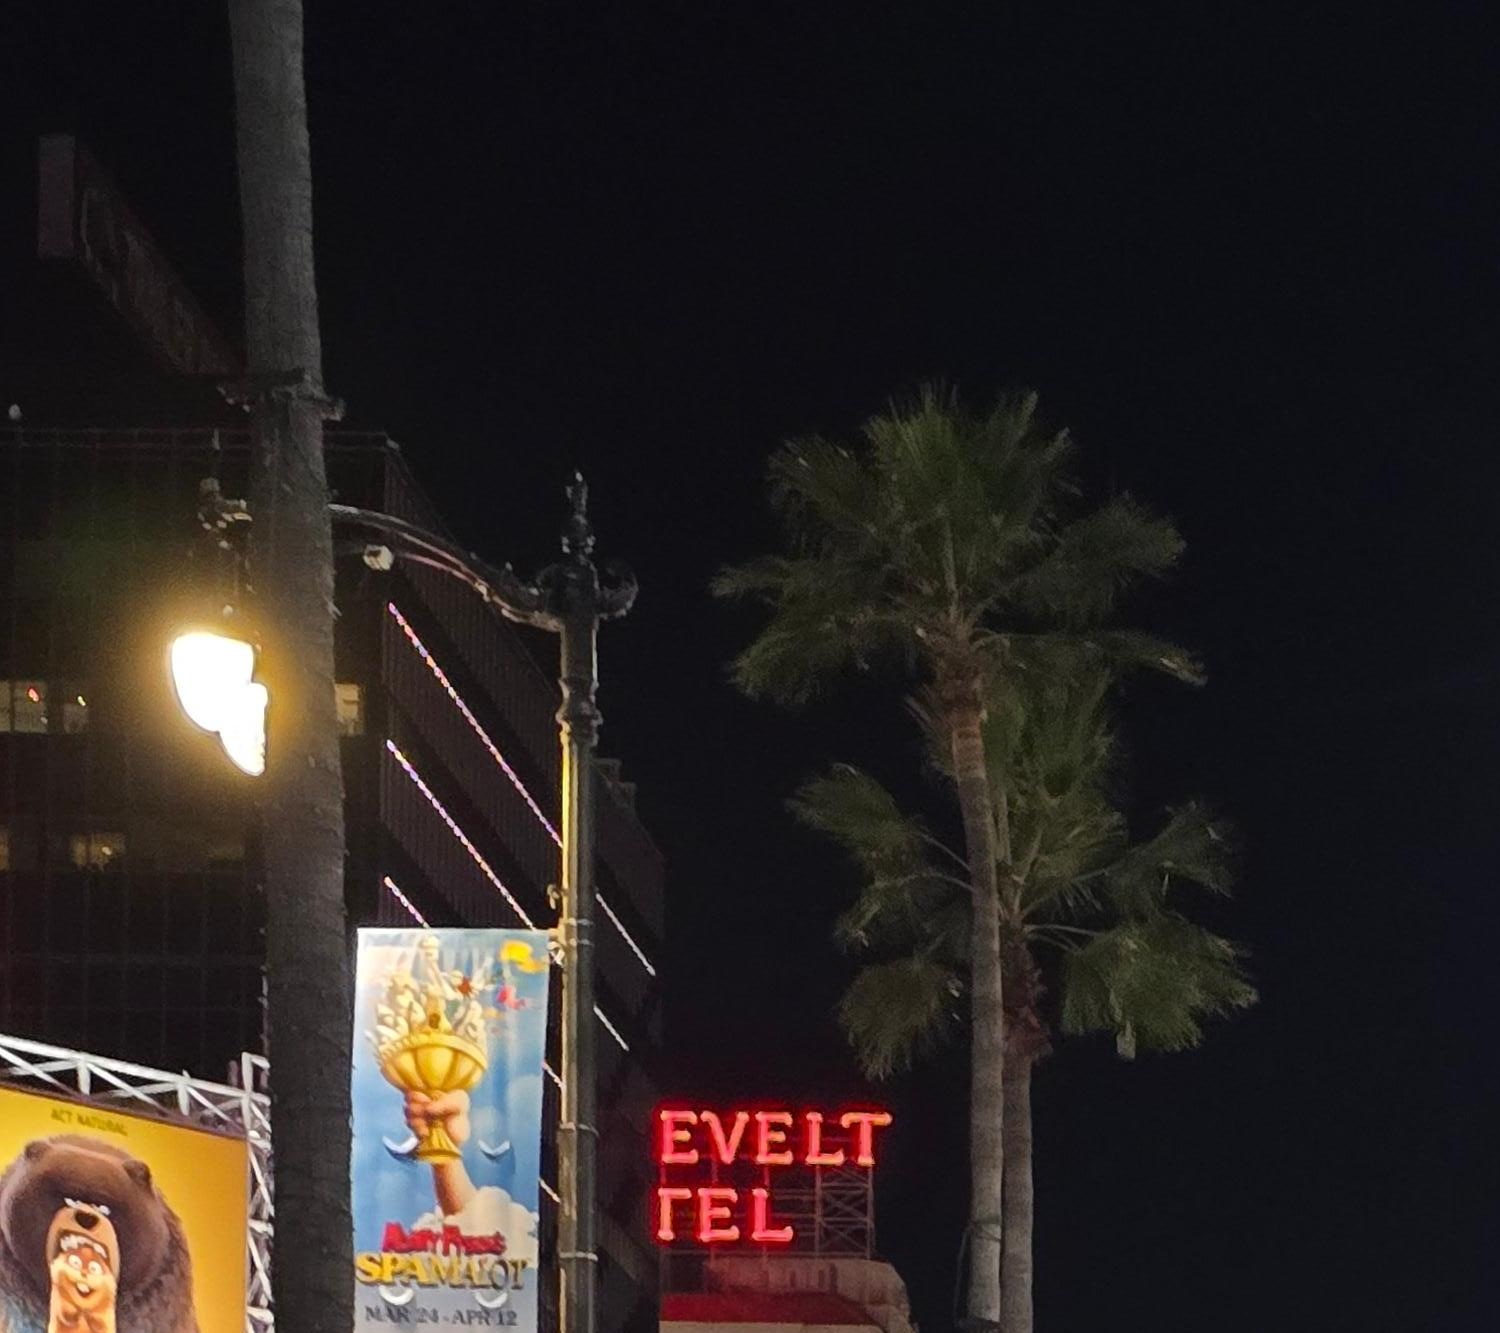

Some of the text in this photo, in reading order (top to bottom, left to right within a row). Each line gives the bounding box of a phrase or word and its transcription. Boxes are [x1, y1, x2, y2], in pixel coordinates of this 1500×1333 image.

[660, 1110, 893, 1166] EVELT
[656, 1187, 794, 1242] TEL
[356, 1252, 527, 1289] SPAMALOT
[365, 1304, 412, 1324] MAR
[453, 1307, 491, 1327] APR
[497, 1308, 518, 1326] 12
